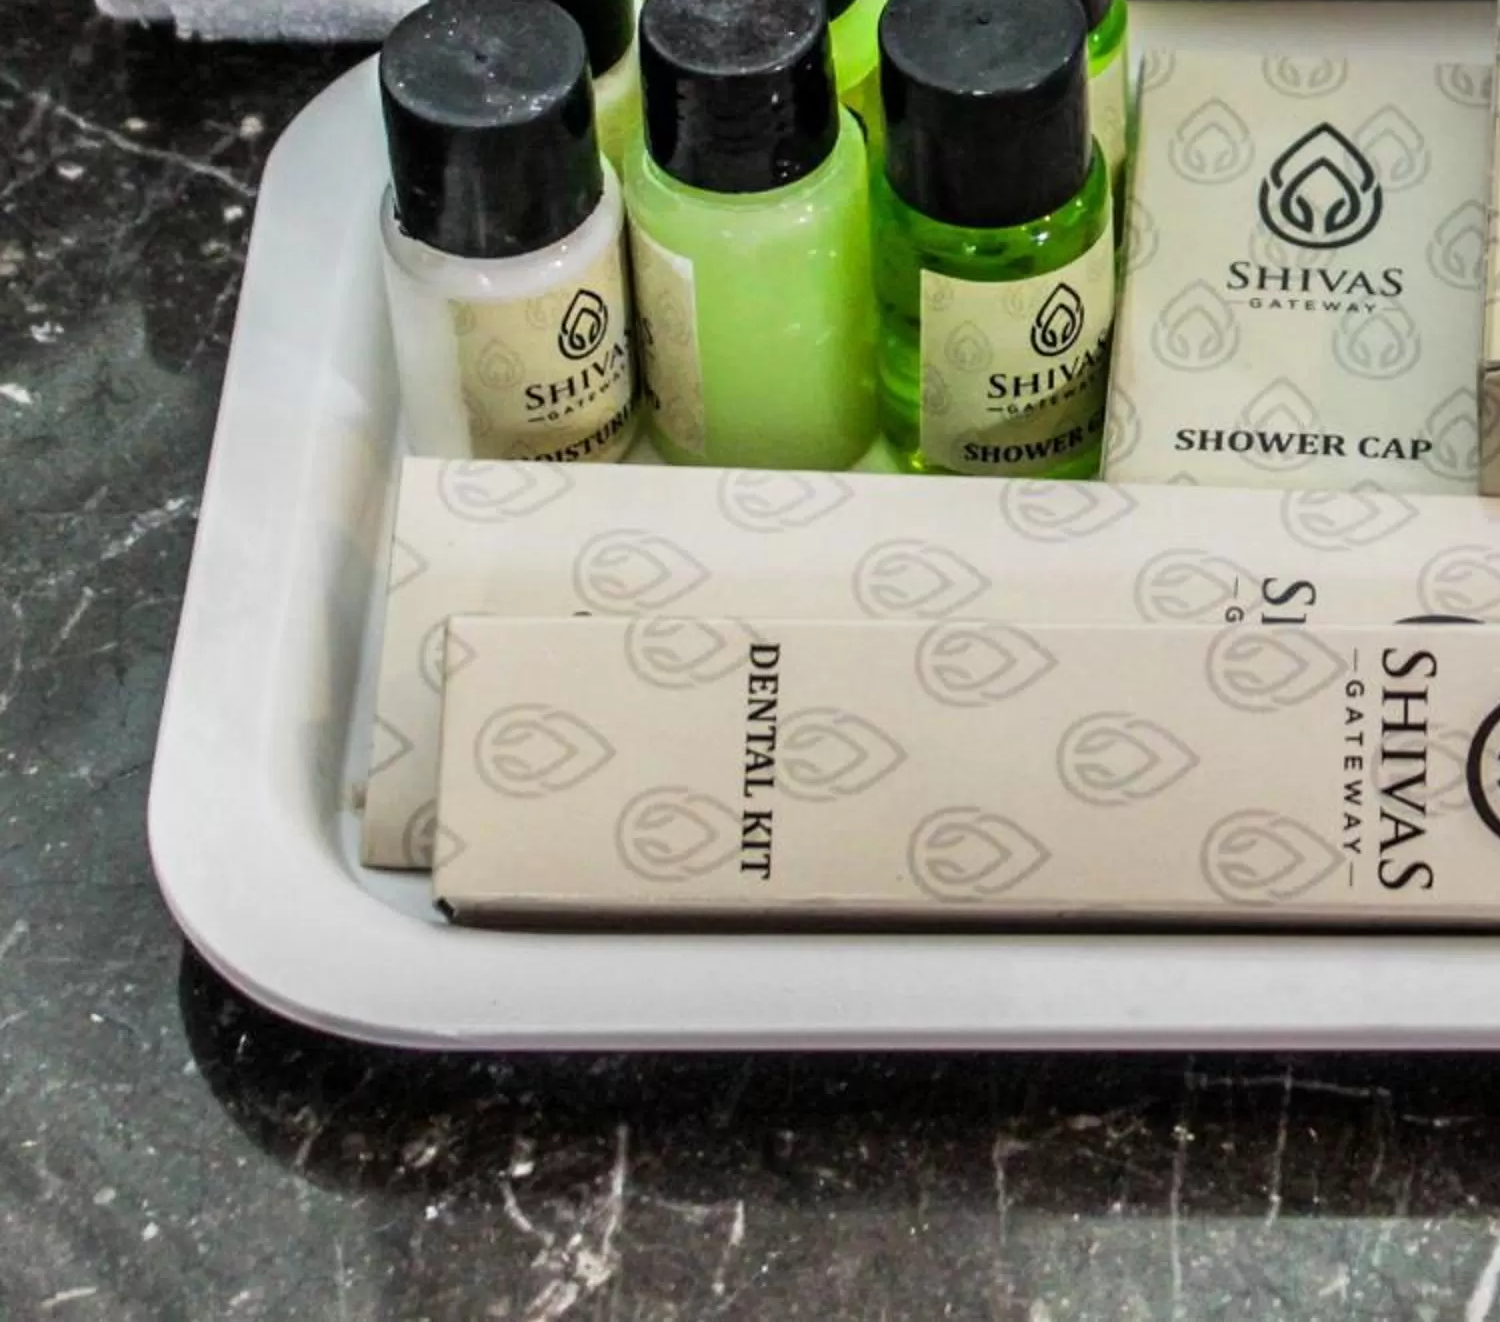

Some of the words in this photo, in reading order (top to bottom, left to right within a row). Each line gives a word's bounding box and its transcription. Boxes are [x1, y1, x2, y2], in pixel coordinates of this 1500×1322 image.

[1226, 261, 1404, 298] SHIVAS
[1249, 298, 1377, 314] GATEWAY
[963, 427, 1084, 464] SHOWER
[1174, 429, 1346, 457] SHOWER
[1358, 436, 1434, 461] CAP
[743, 643, 781, 799] DENTAL
[1343, 679, 1365, 855] GATEWAY
[1377, 647, 1438, 891] SHIVAS
[740, 809, 773, 881] KIT
